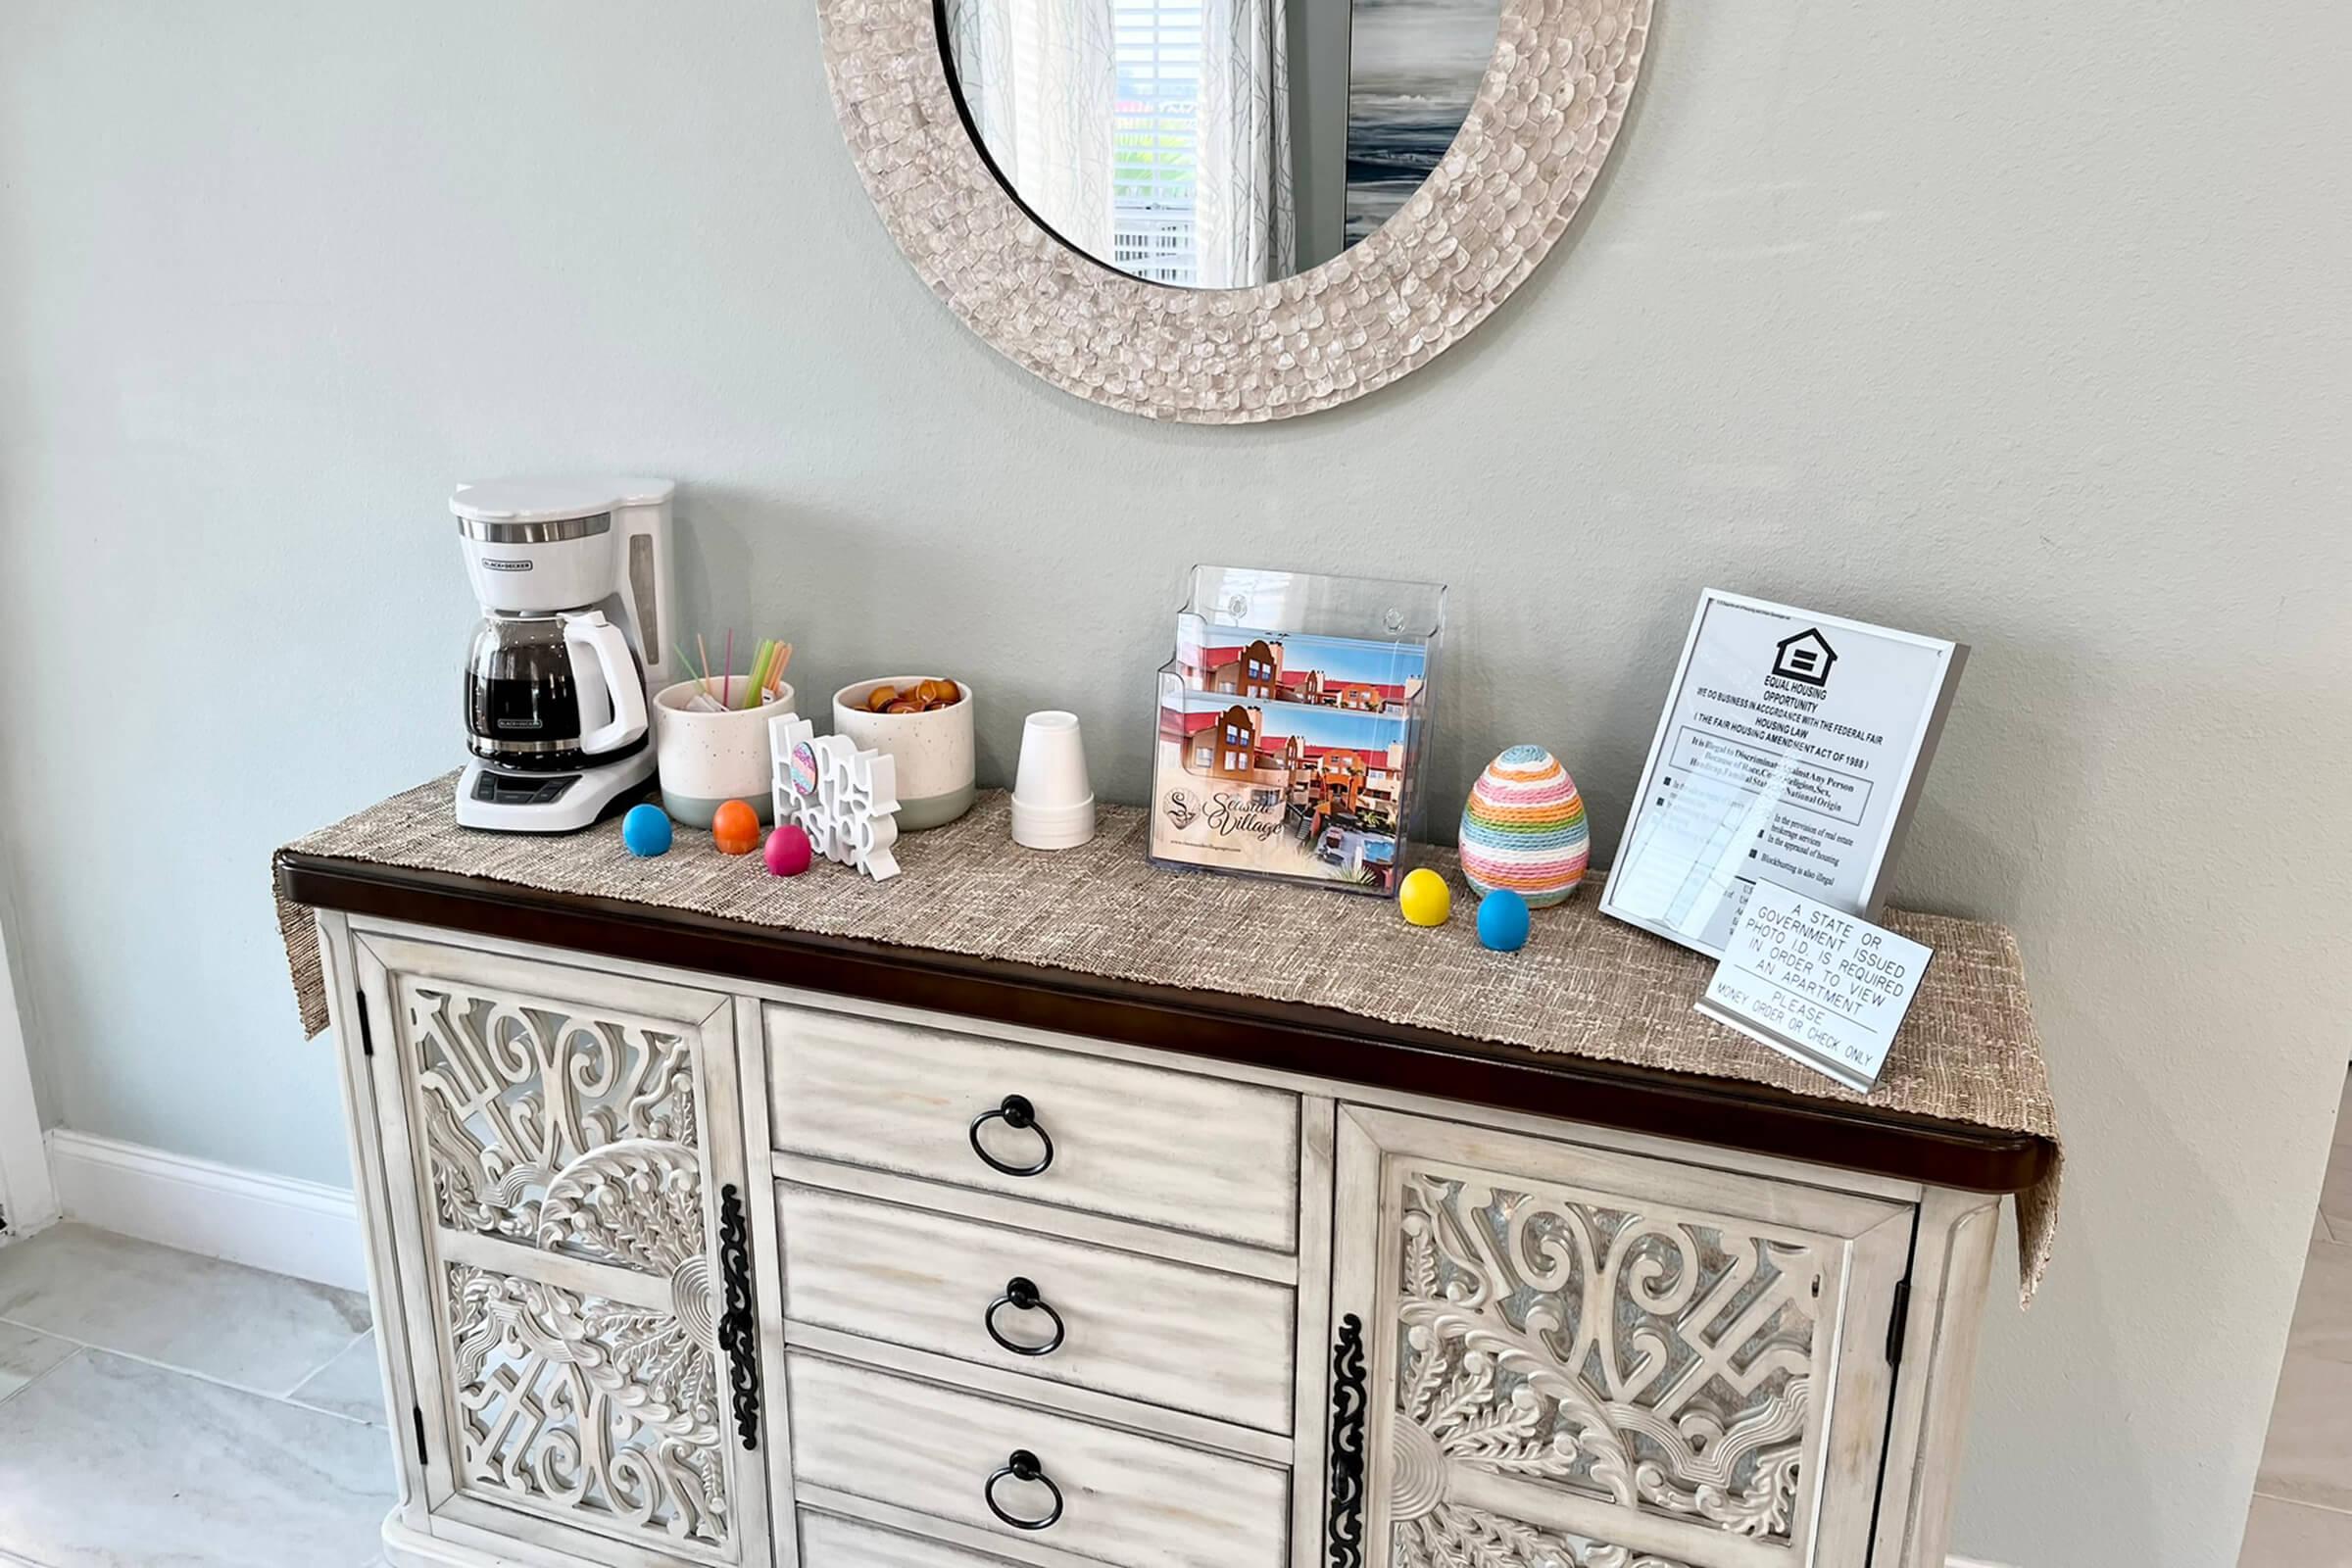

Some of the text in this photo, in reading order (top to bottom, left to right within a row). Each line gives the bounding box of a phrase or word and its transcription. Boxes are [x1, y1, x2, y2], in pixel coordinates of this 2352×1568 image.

[1764, 675, 1827, 700] EQUAL HOUSING
[1764, 691, 1818, 712] OPPORTUNITY
[1697, 688, 1707, 697] WE
[1707, 690, 1717, 700] DO
[1717, 692, 1748, 709] BUSINESS
[1756, 704, 1801, 722] ACCORDANCE
[1801, 716, 1819, 727] WITH
[1820, 720, 1834, 732] THE
[1834, 724, 1864, 741] FEDERAL
[1866, 733, 1883, 745] FAIR
[1755, 717, 1808, 738] HOUSING LAW
[1699, 713, 1713, 724] THE
[1713, 717, 1731, 729] FAIR
[1731, 723, 1765, 740] HOUSING
[1766, 733, 1815, 753] AMENDMENT
[1815, 748, 1833, 759] ACT
[1833, 753, 1844, 761] OF
[1846, 757, 1864, 768] 1988
[1787, 787, 1817, 804] National
[1817, 798, 1841, 811] Origin
[1811, 773, 1825, 785] Any
[1827, 777, 1854, 792] Person
[1206, 809, 1283, 841] Village
[1771, 825, 1821, 847] brokerage services
[1774, 813, 1781, 822] In
[1782, 816, 1790, 825] the
[1789, 821, 1817, 834] provision
[1768, 834, 1774, 843] In
[1784, 842, 1809, 855] appraisal
[1817, 851, 1839, 867] housing
[1761, 854, 1796, 874] Blockbusting
[1803, 869, 1815, 878] also
[1816, 872, 1835, 886] illegal
[1758, 906, 1905, 978] GOVERNMENT ISSUED
[1792, 905, 1882, 950] A STATE OR
[1746, 918, 1786, 944] PHOTO
[1791, 939, 1809, 956] I.D.
[1819, 951, 1832, 964] IS
[1838, 959, 1903, 997] REQUIRED
[1749, 938, 1886, 1006] IN ORDER TO VIEW
[1756, 959, 1863, 1014] AN APARTMENT
[1717, 983, 1873, 1066] MONEY ORDER OR CHECK ONLY
[1772, 991, 1825, 1025] PLEASE
